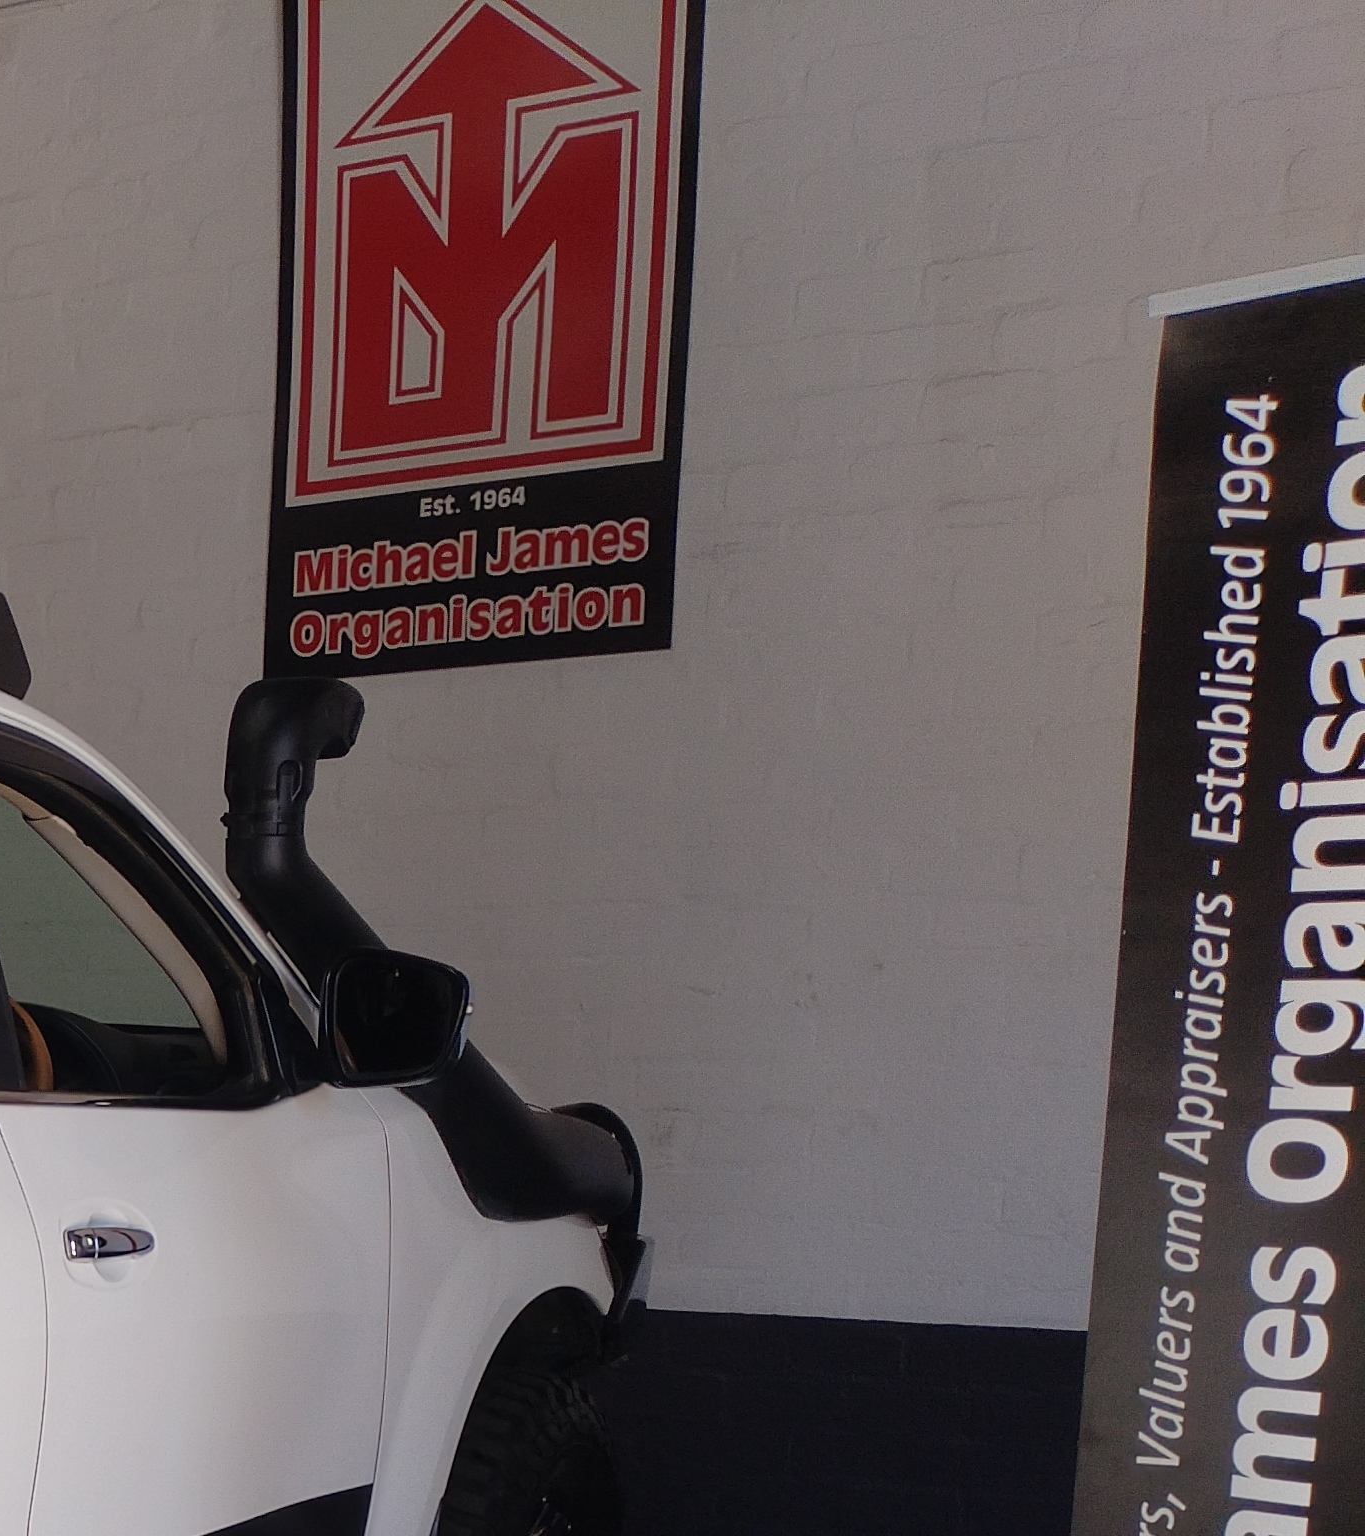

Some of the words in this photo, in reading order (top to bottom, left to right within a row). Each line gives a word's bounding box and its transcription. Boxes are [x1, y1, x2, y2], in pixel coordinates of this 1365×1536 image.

[419, 494, 461, 518] Est.
[470, 486, 526, 512] 1964
[1218, 394, 1278, 529] 1964
[292, 530, 478, 598] Michael
[486, 517, 650, 576] James
[289, 583, 646, 659] Organisation
[1190, 546, 1266, 844] Established
[1165, 891, 1234, 1165] Appraisers
[1158, 1171, 1207, 1273] and
[1135, 1286, 1196, 1468] Valuers
